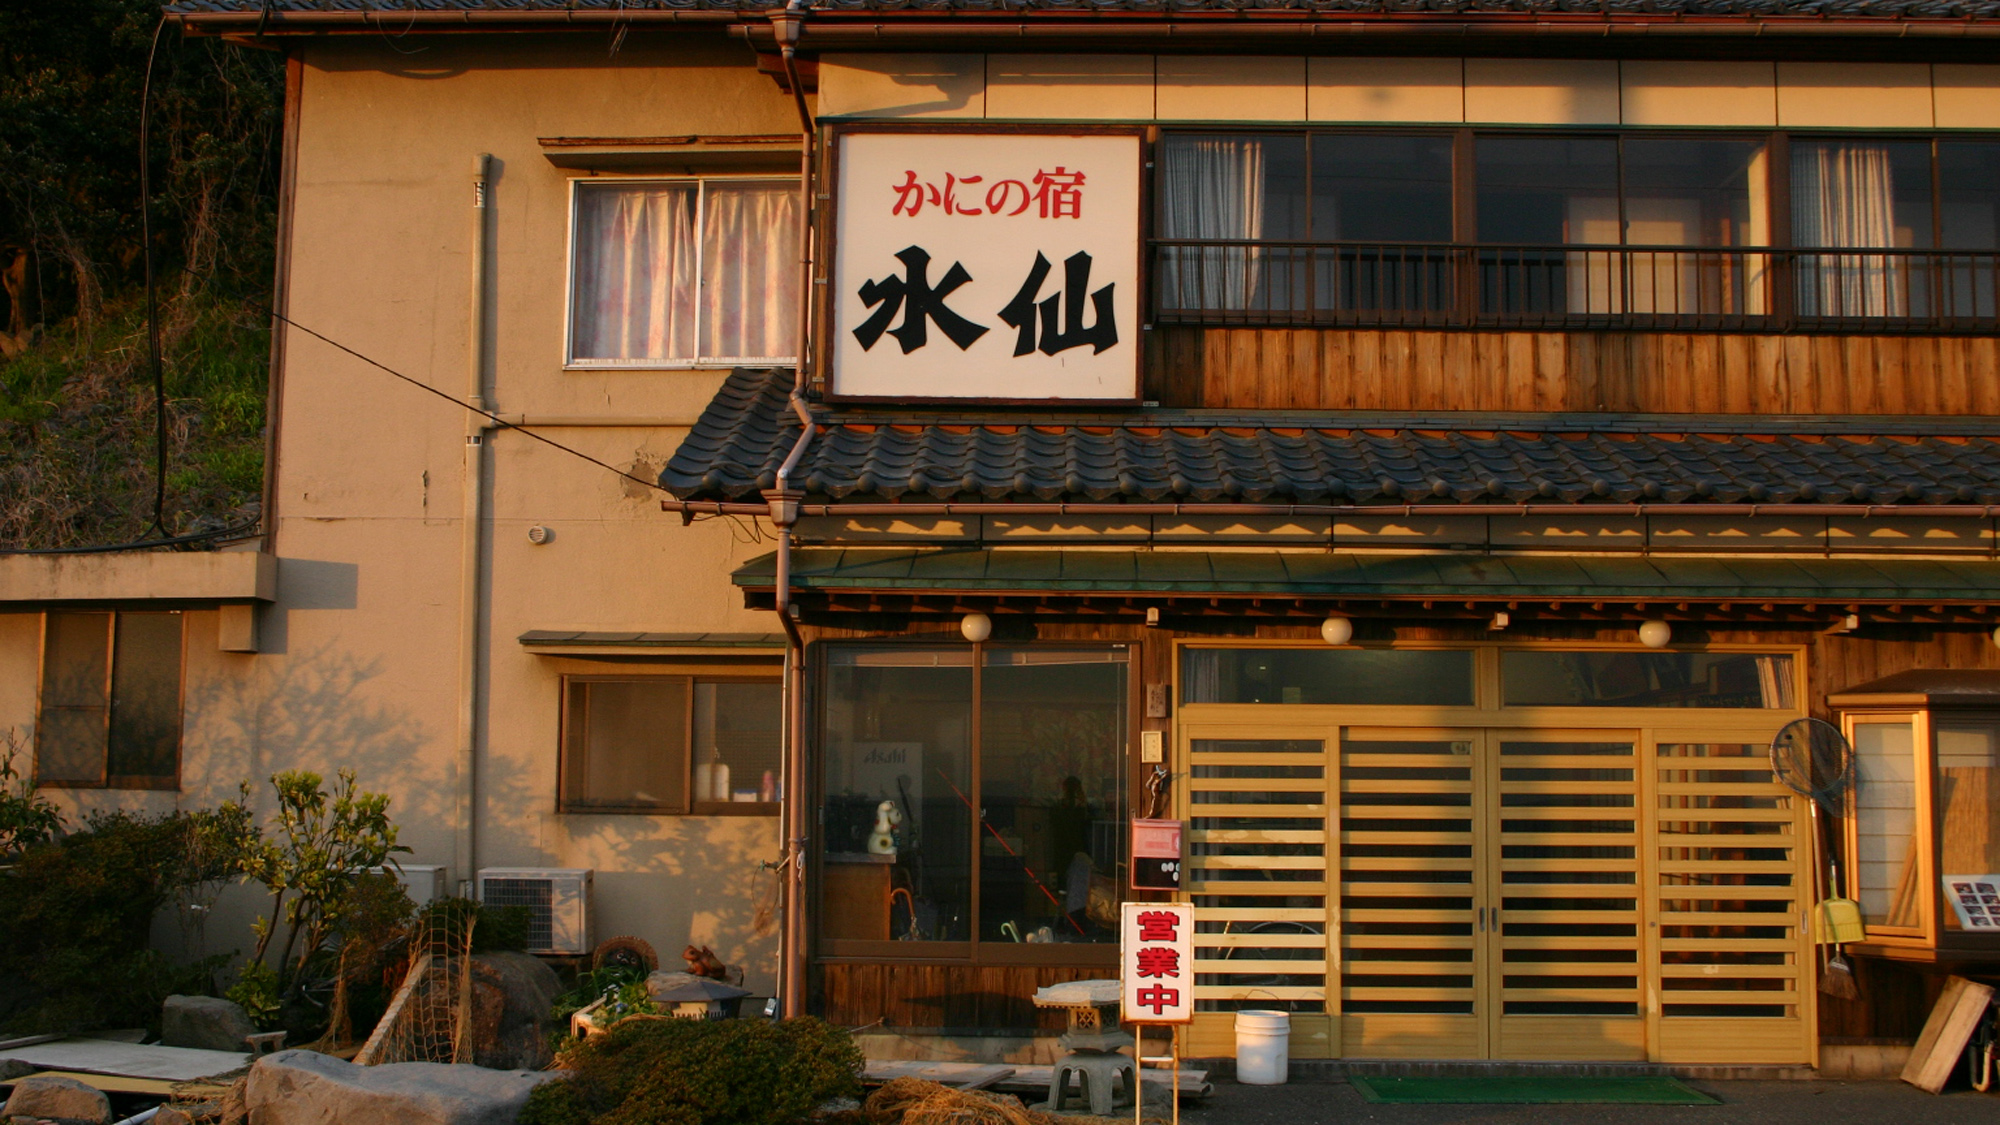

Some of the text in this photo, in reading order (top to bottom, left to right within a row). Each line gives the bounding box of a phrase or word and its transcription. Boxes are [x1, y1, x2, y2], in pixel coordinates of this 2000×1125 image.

[892, 166, 1086, 219] かにの宿
[852, 244, 1119, 357] 水仙
[864, 747, 907, 764] Asahi
[1137, 910, 1180, 1015] 営業中
